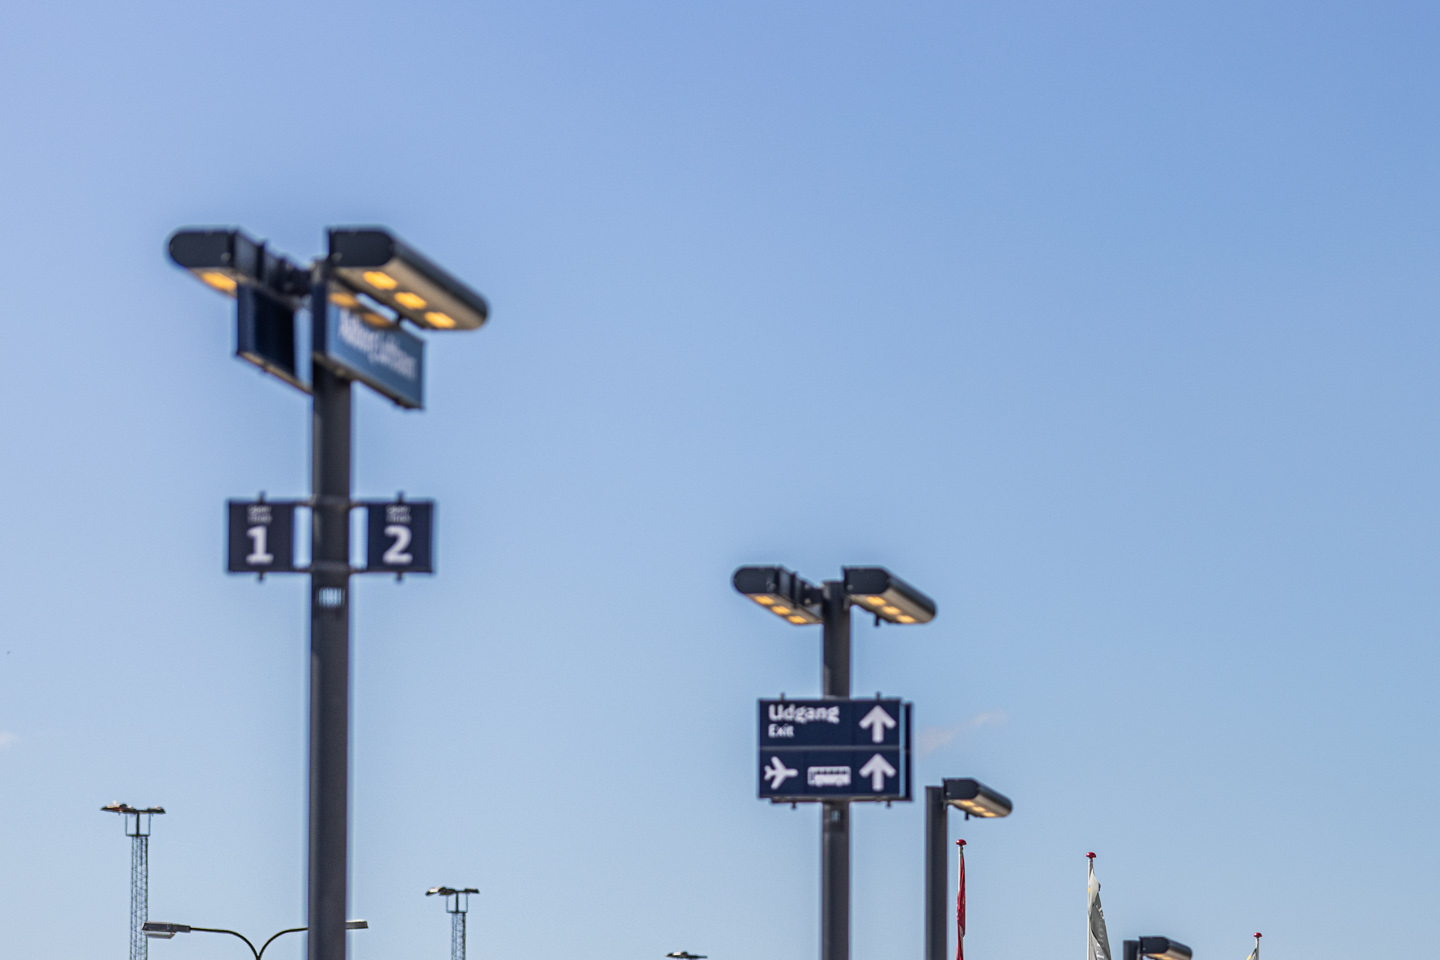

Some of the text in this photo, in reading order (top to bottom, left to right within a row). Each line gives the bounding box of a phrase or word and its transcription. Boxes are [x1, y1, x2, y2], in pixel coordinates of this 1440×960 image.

[246, 526, 275, 565] 1
[383, 525, 413, 565] 2
[768, 704, 840, 724] Udgang
[768, 723, 794, 738] Exit
